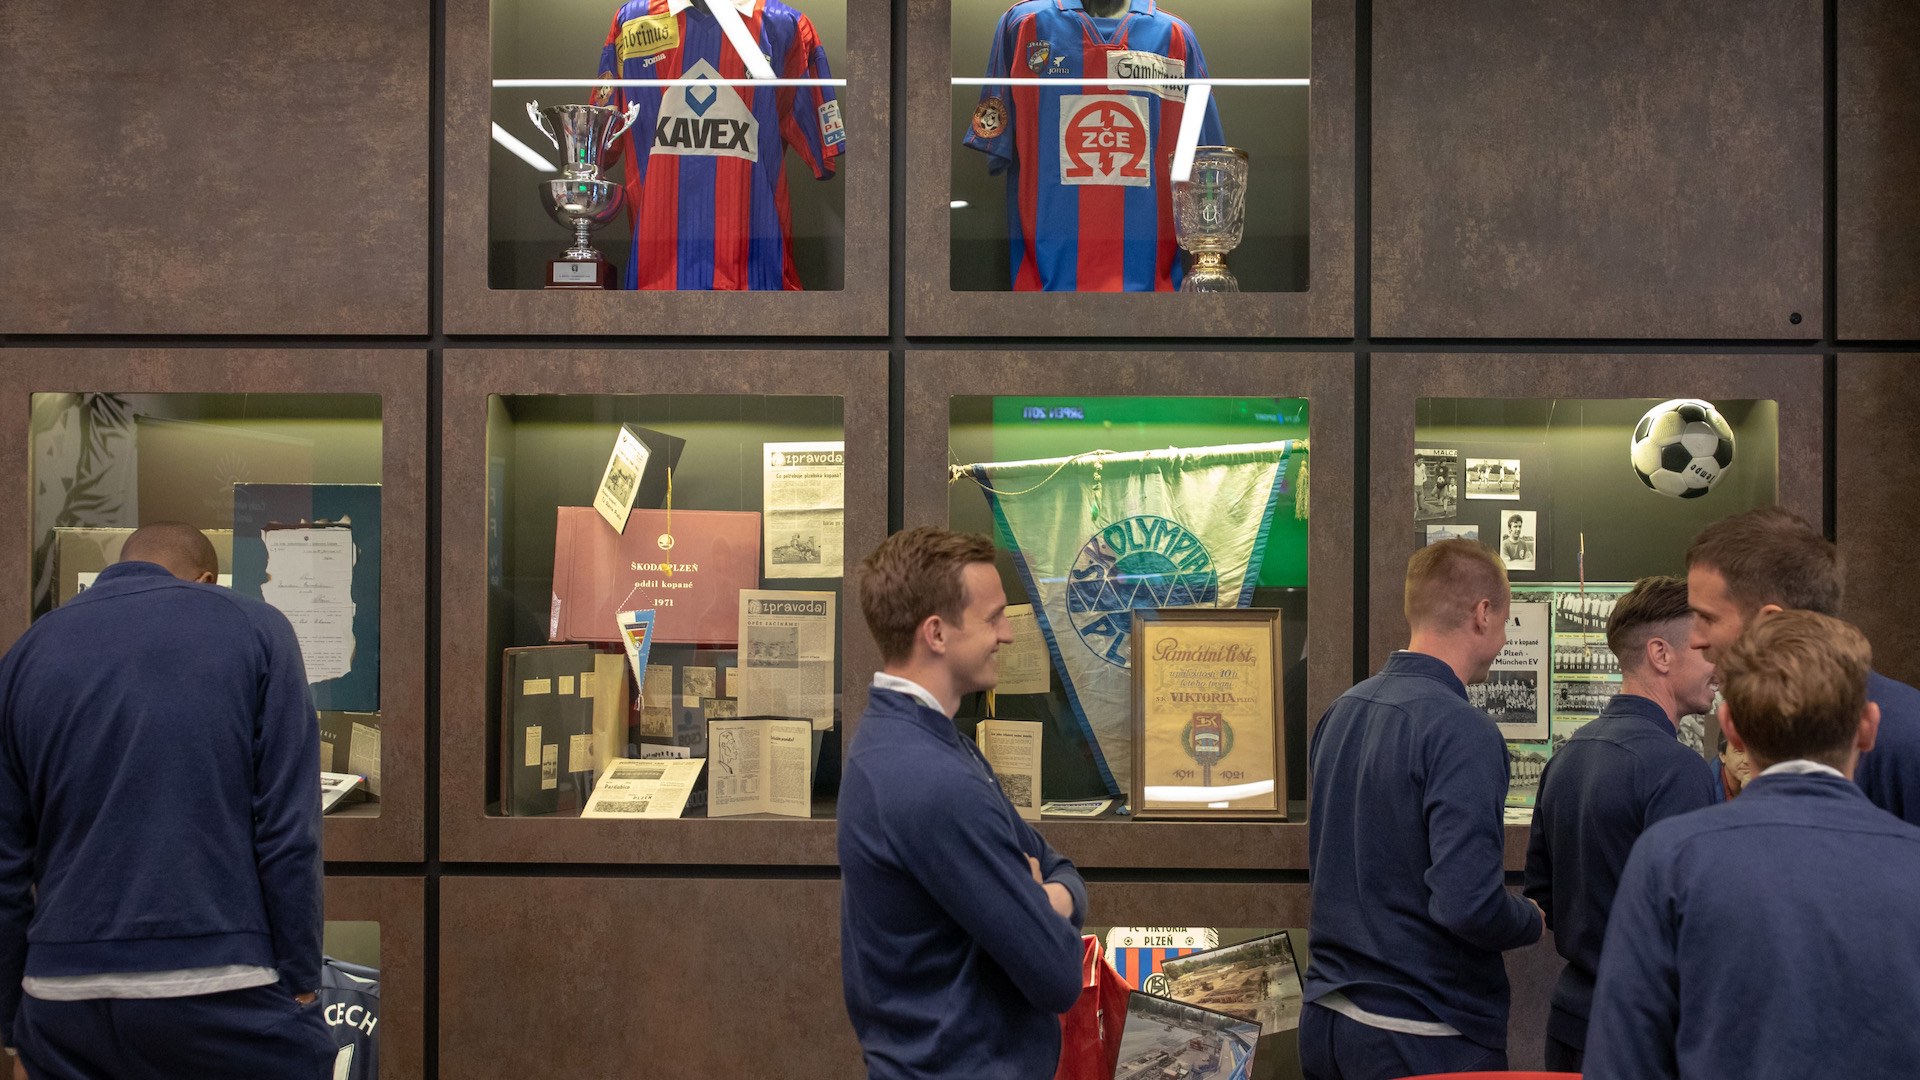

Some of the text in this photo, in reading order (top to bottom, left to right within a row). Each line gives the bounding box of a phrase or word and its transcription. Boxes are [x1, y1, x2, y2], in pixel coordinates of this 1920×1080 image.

[643, 53, 666, 67] Joma
[653, 116, 750, 152] KAVEX
[1082, 127, 1130, 148] ZČE
[1103, 518, 1210, 573] OLYMPIA
[631, 561, 698, 572] ŠKODA PLZEŇ
[661, 581, 693, 589] kopané
[654, 598, 674, 607] 1971
[762, 600, 826, 615] zpravodaj
[1170, 692, 1236, 702] VIKTORIA
[1172, 769, 1245, 781] 1911 1921
[1144, 935, 1173, 946] PLZEŇ
[324, 1003, 378, 1036] CECH
